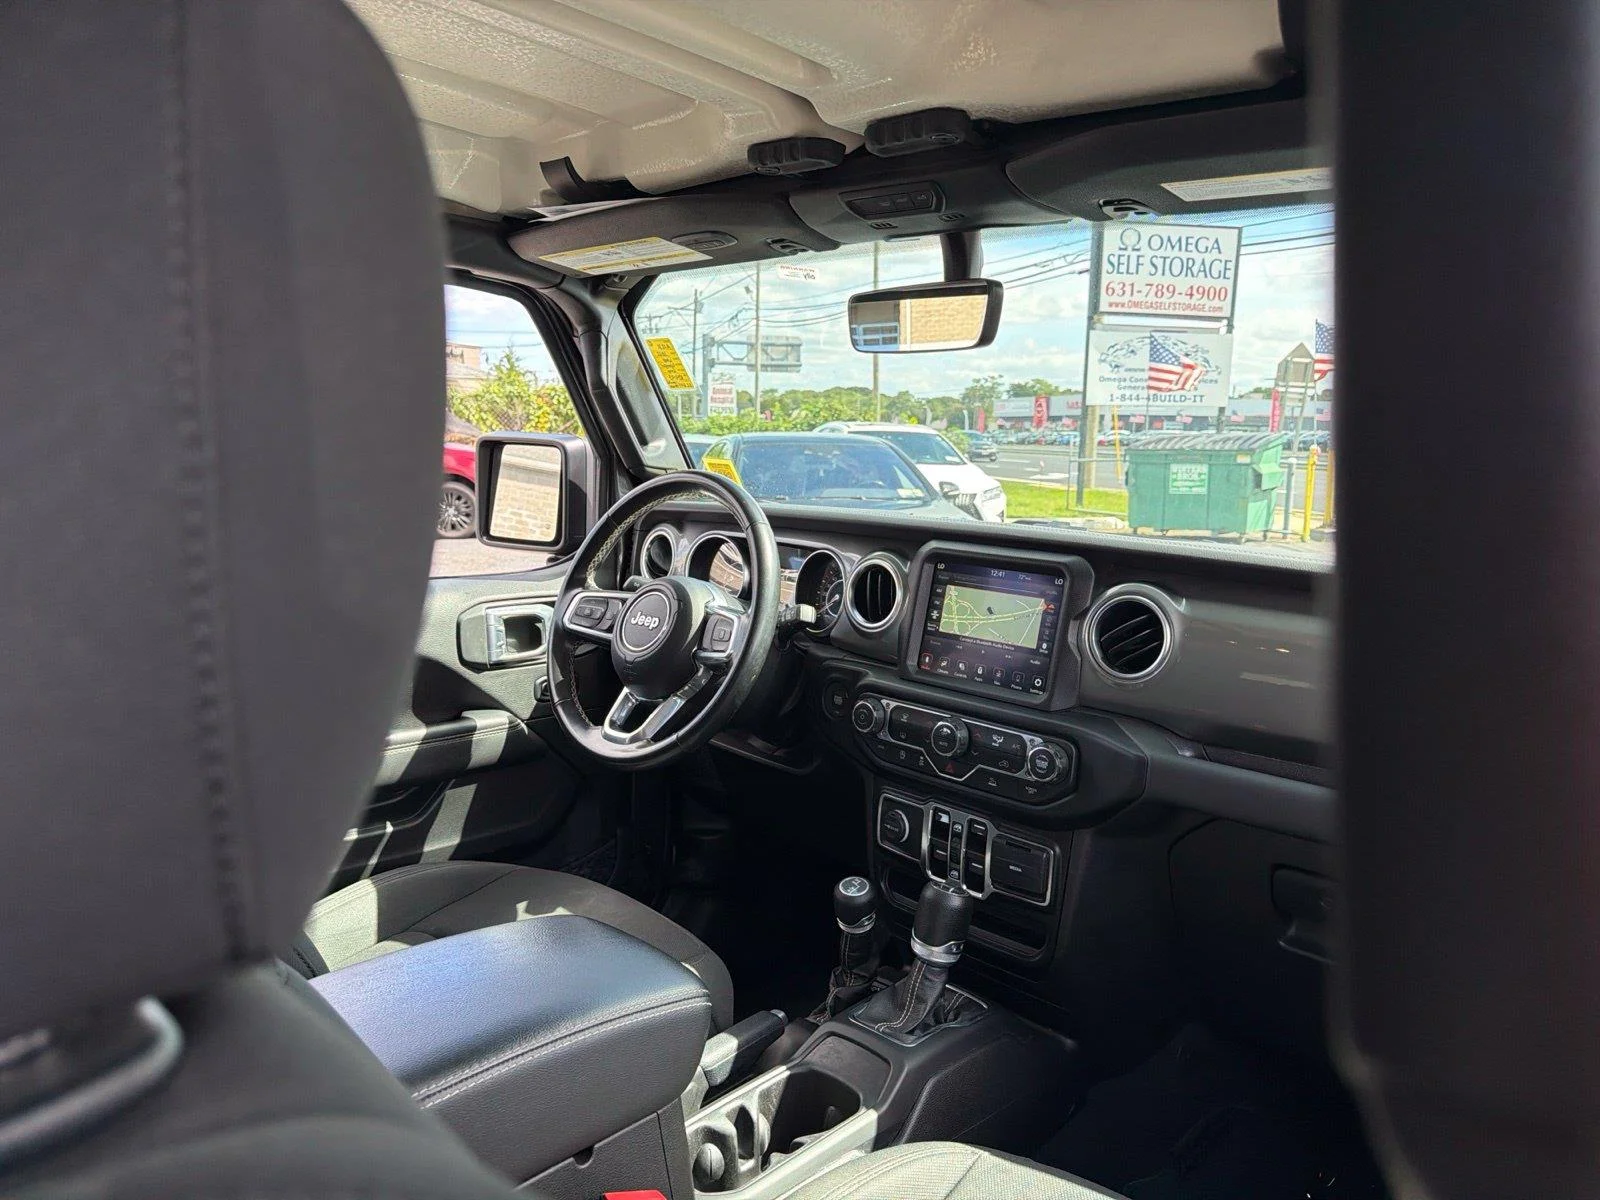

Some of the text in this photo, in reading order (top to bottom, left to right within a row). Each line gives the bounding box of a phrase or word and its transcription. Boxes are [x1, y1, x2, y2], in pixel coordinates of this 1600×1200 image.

[1147, 233, 1222, 254] OMEGA
[1106, 253, 1233, 280] SELF STORAGE
[1105, 280, 1229, 302] 631-789-4900
[1108, 299, 1224, 313] www.OMEGASELFSTORAGE.com
[1098, 375, 1127, 384] Omega
[1117, 384, 1146, 392] Genera
[991, 569, 1005, 578] 12:41
[631, 611, 660, 631] Jeep
